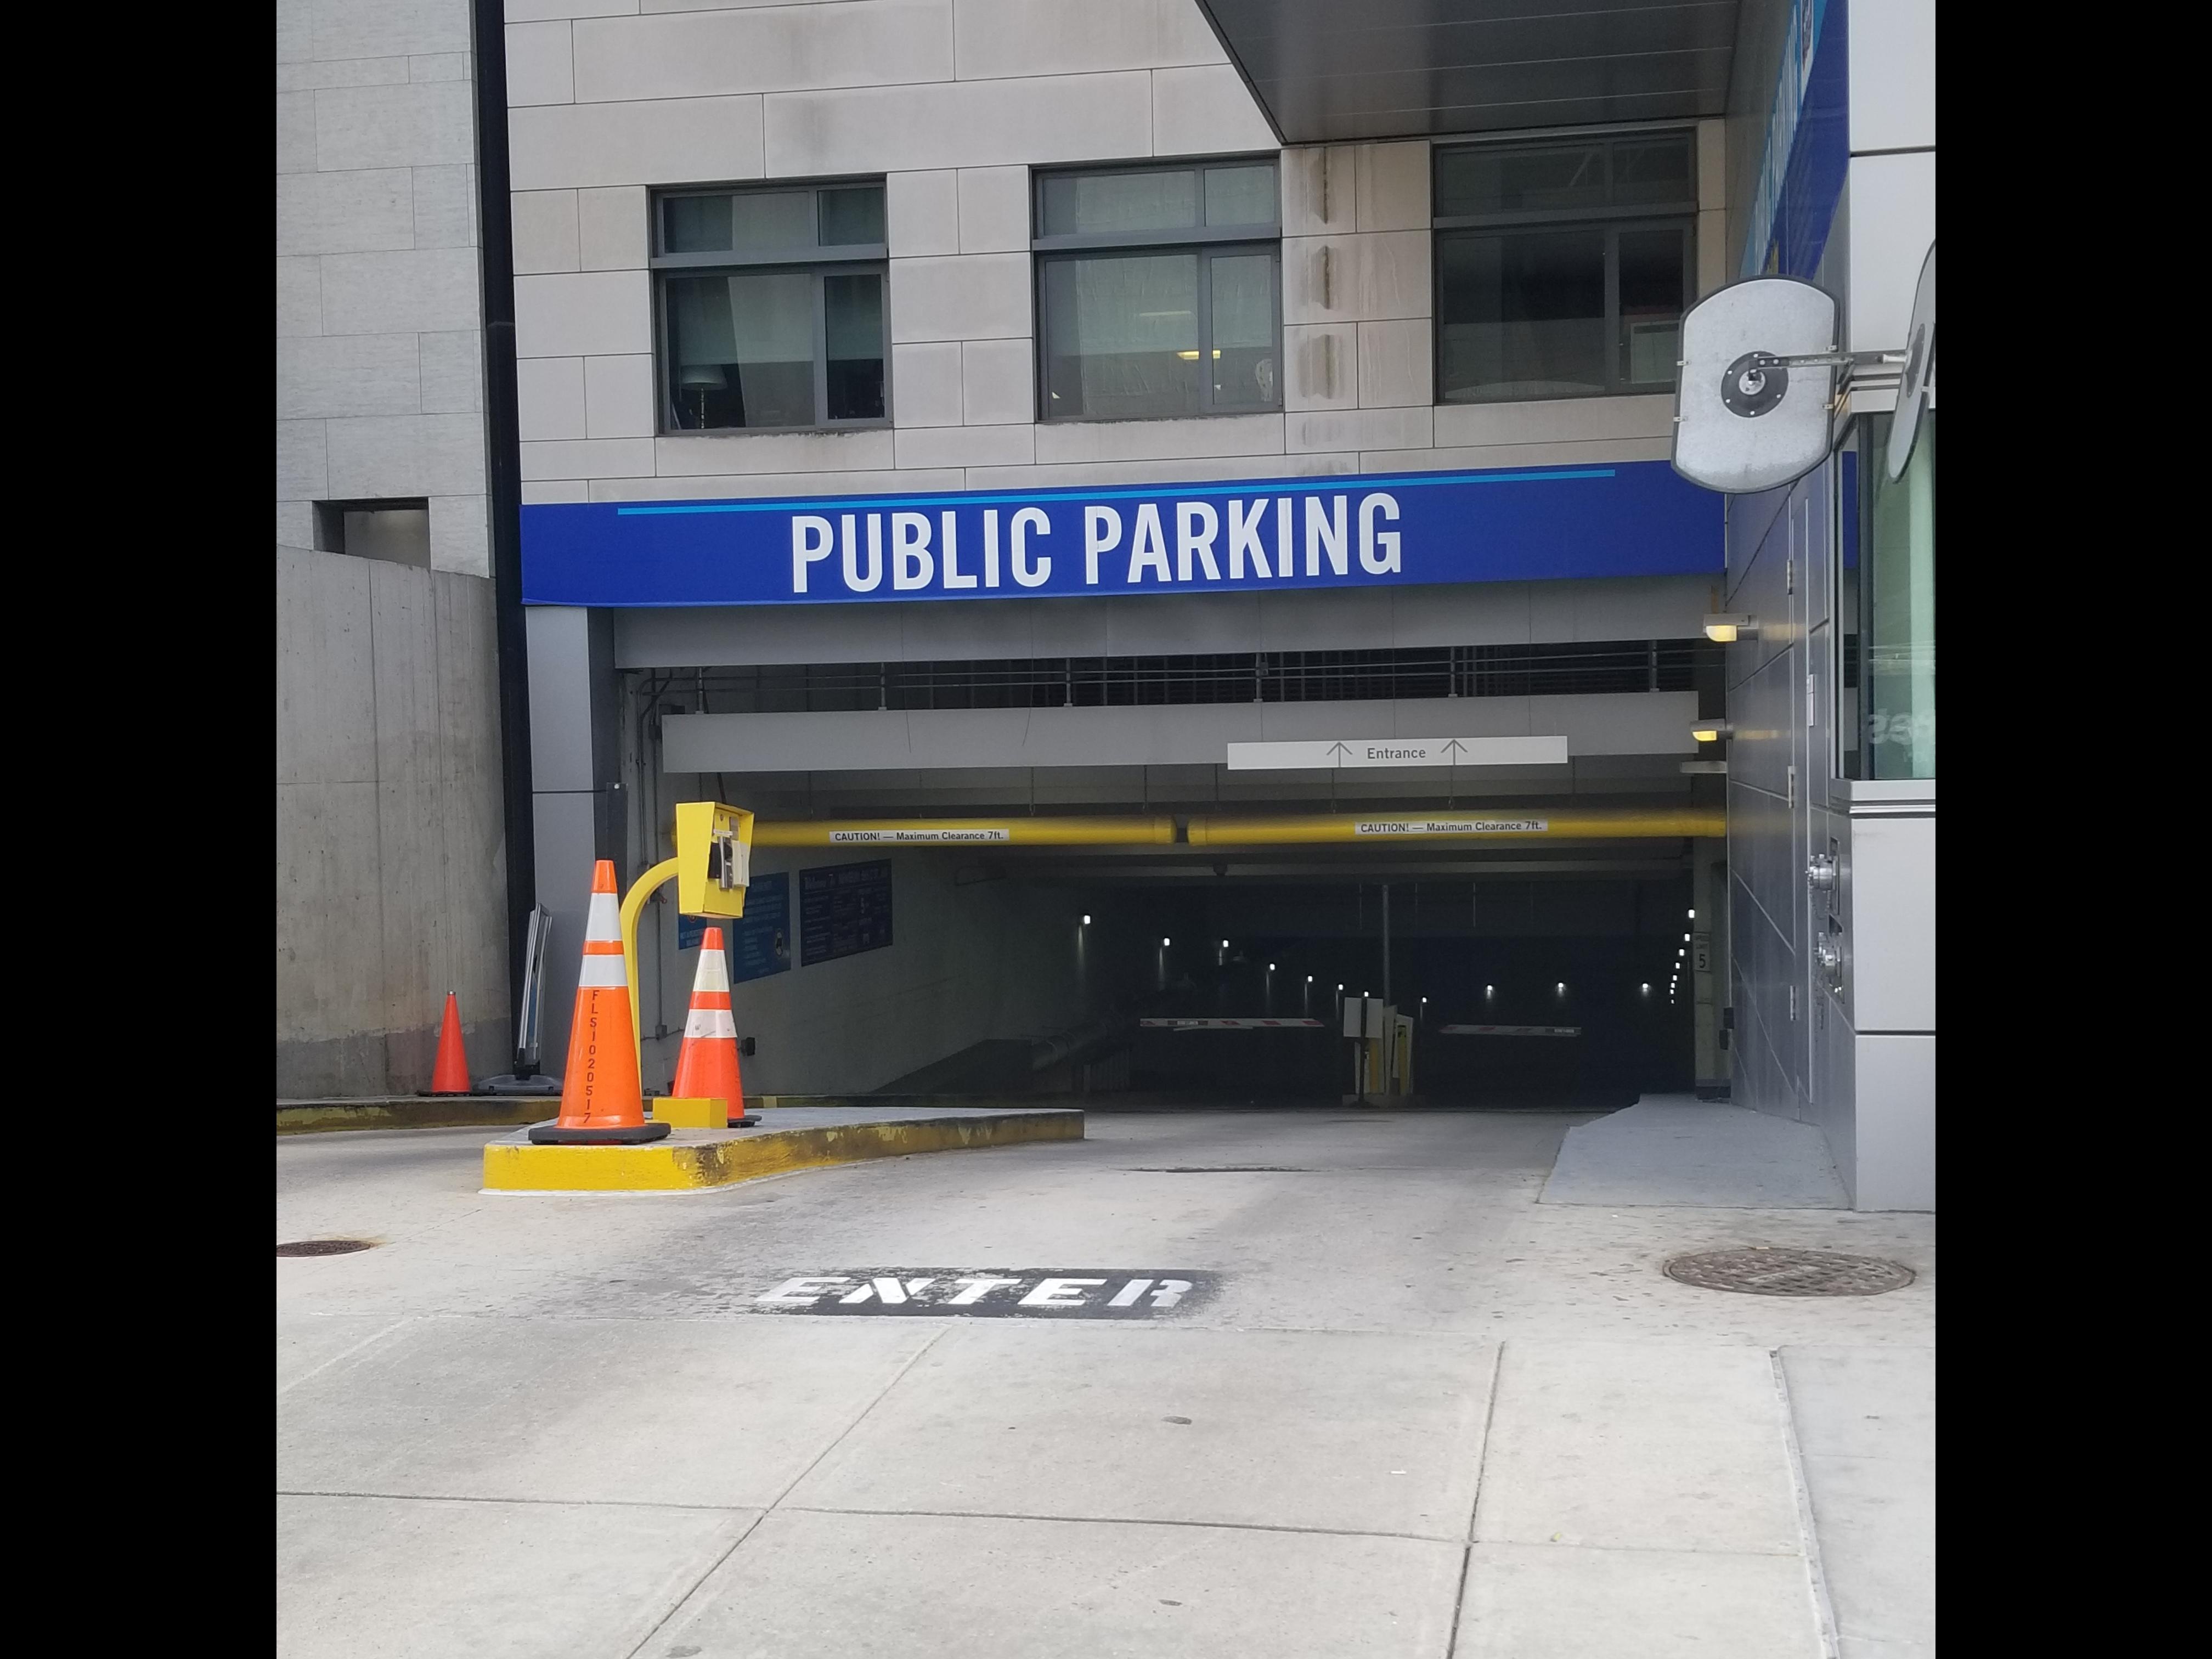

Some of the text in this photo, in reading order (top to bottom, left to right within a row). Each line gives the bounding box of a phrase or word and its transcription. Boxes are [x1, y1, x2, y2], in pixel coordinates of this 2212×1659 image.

[792, 493, 1401, 592] PUBLIC PARKING
[1367, 747, 1426, 760] Entrance
[1361, 823, 1409, 832] CAUTION!
[1427, 822, 1472, 831] Maximum
[1476, 821, 1521, 831] Clearance
[1525, 821, 1542, 830] 7ft.
[835, 832, 881, 841] CAUTION!
[896, 832, 939, 840] Maximum
[942, 831, 985, 840] Clearance
[988, 831, 1004, 839] 7ft.
[1699, 953, 1706, 968] 5
[754, 1276, 1194, 1308] ENTER
